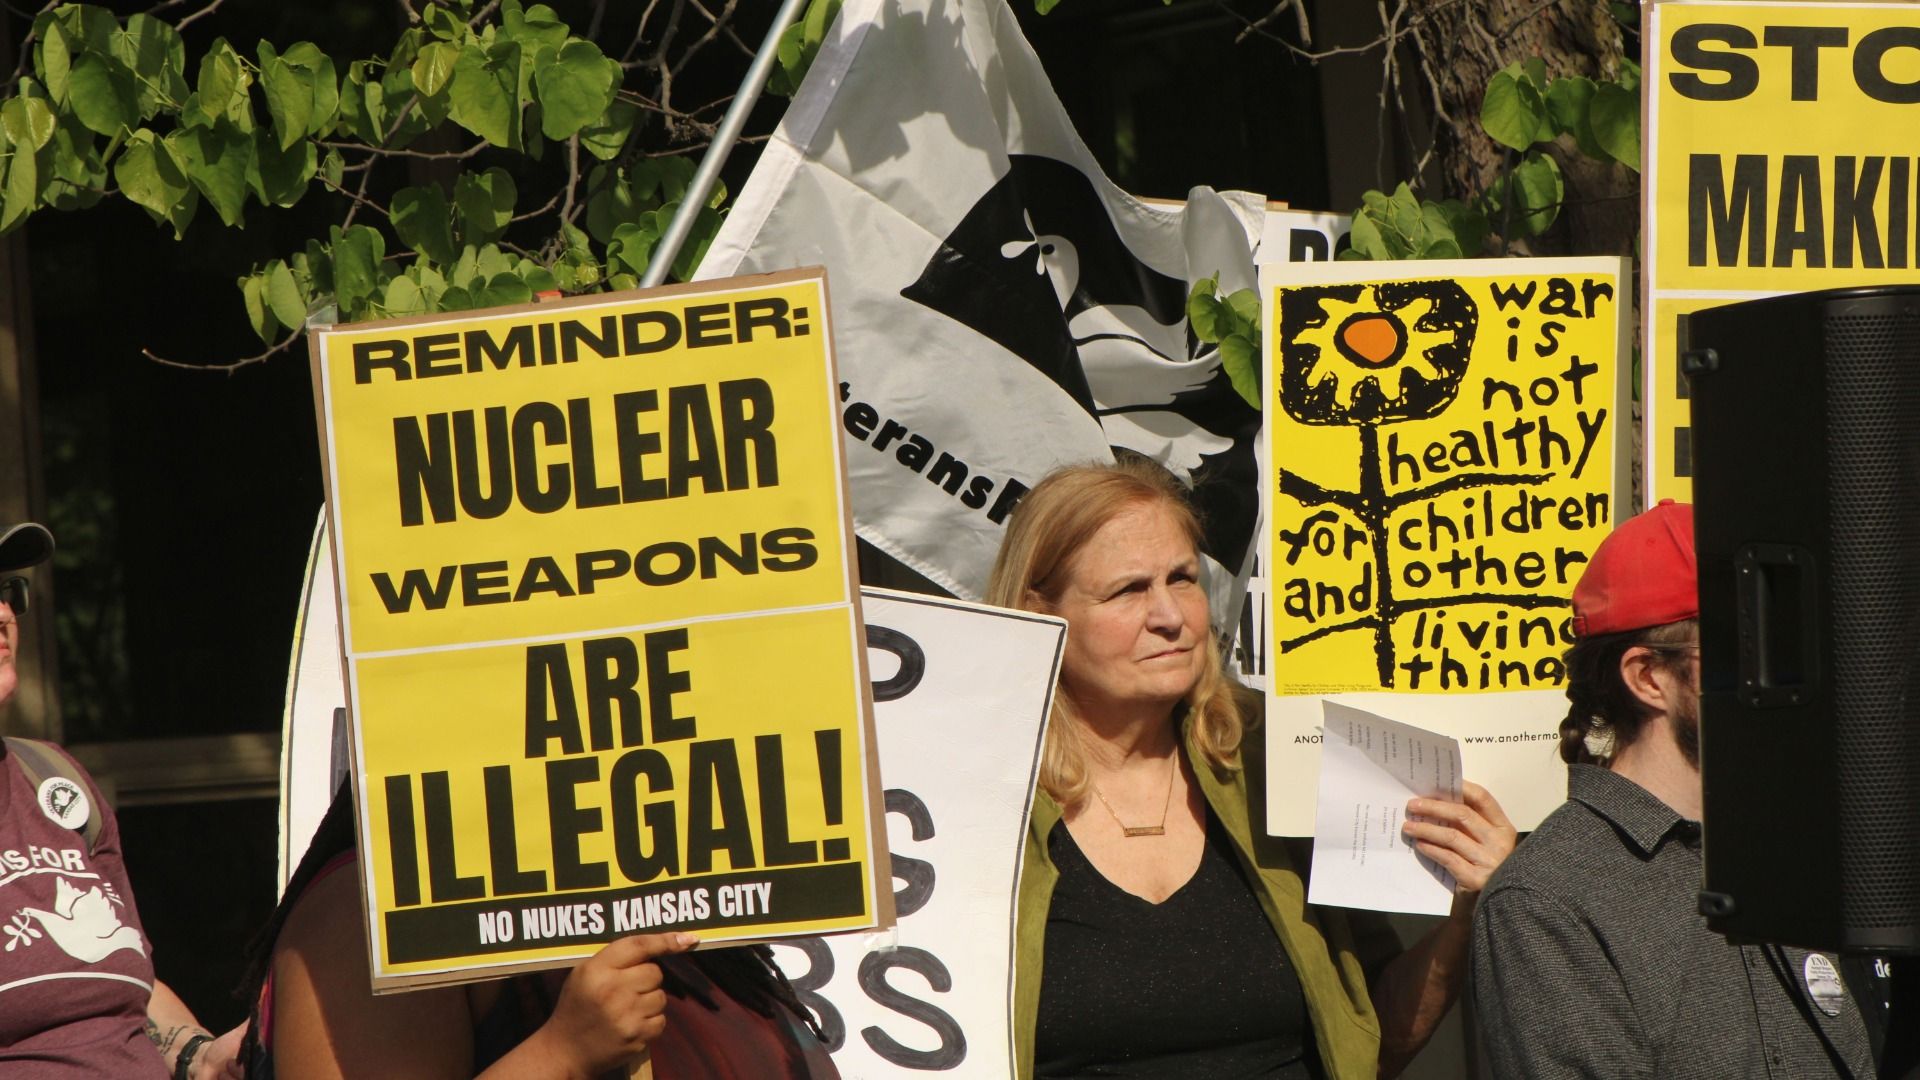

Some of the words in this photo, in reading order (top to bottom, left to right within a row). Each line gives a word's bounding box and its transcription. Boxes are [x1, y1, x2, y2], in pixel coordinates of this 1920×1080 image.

[1688, 153, 1920, 269] MAKI
[1489, 278, 1614, 318] war
[353, 297, 810, 385] REMINDER:
[1507, 317, 1566, 362] is
[1483, 355, 1599, 412] not
[393, 377, 780, 527] NUCLEAR
[1387, 409, 1607, 486] healthy
[1398, 490, 1609, 552] children
[369, 527, 819, 615] WEAPONS
[1284, 562, 1372, 623] and
[1403, 545, 1588, 589] other
[525, 627, 697, 760] ARE
[1464, 730, 1560, 744] www.anothermo
[384, 728, 852, 908] ILLEGAL!
[29, 845, 86, 871] FOR
[478, 911, 513, 945] NO
[522, 904, 605, 941] NUKES
[612, 888, 711, 932] KANSAS
[718, 882, 773, 919] CITY
